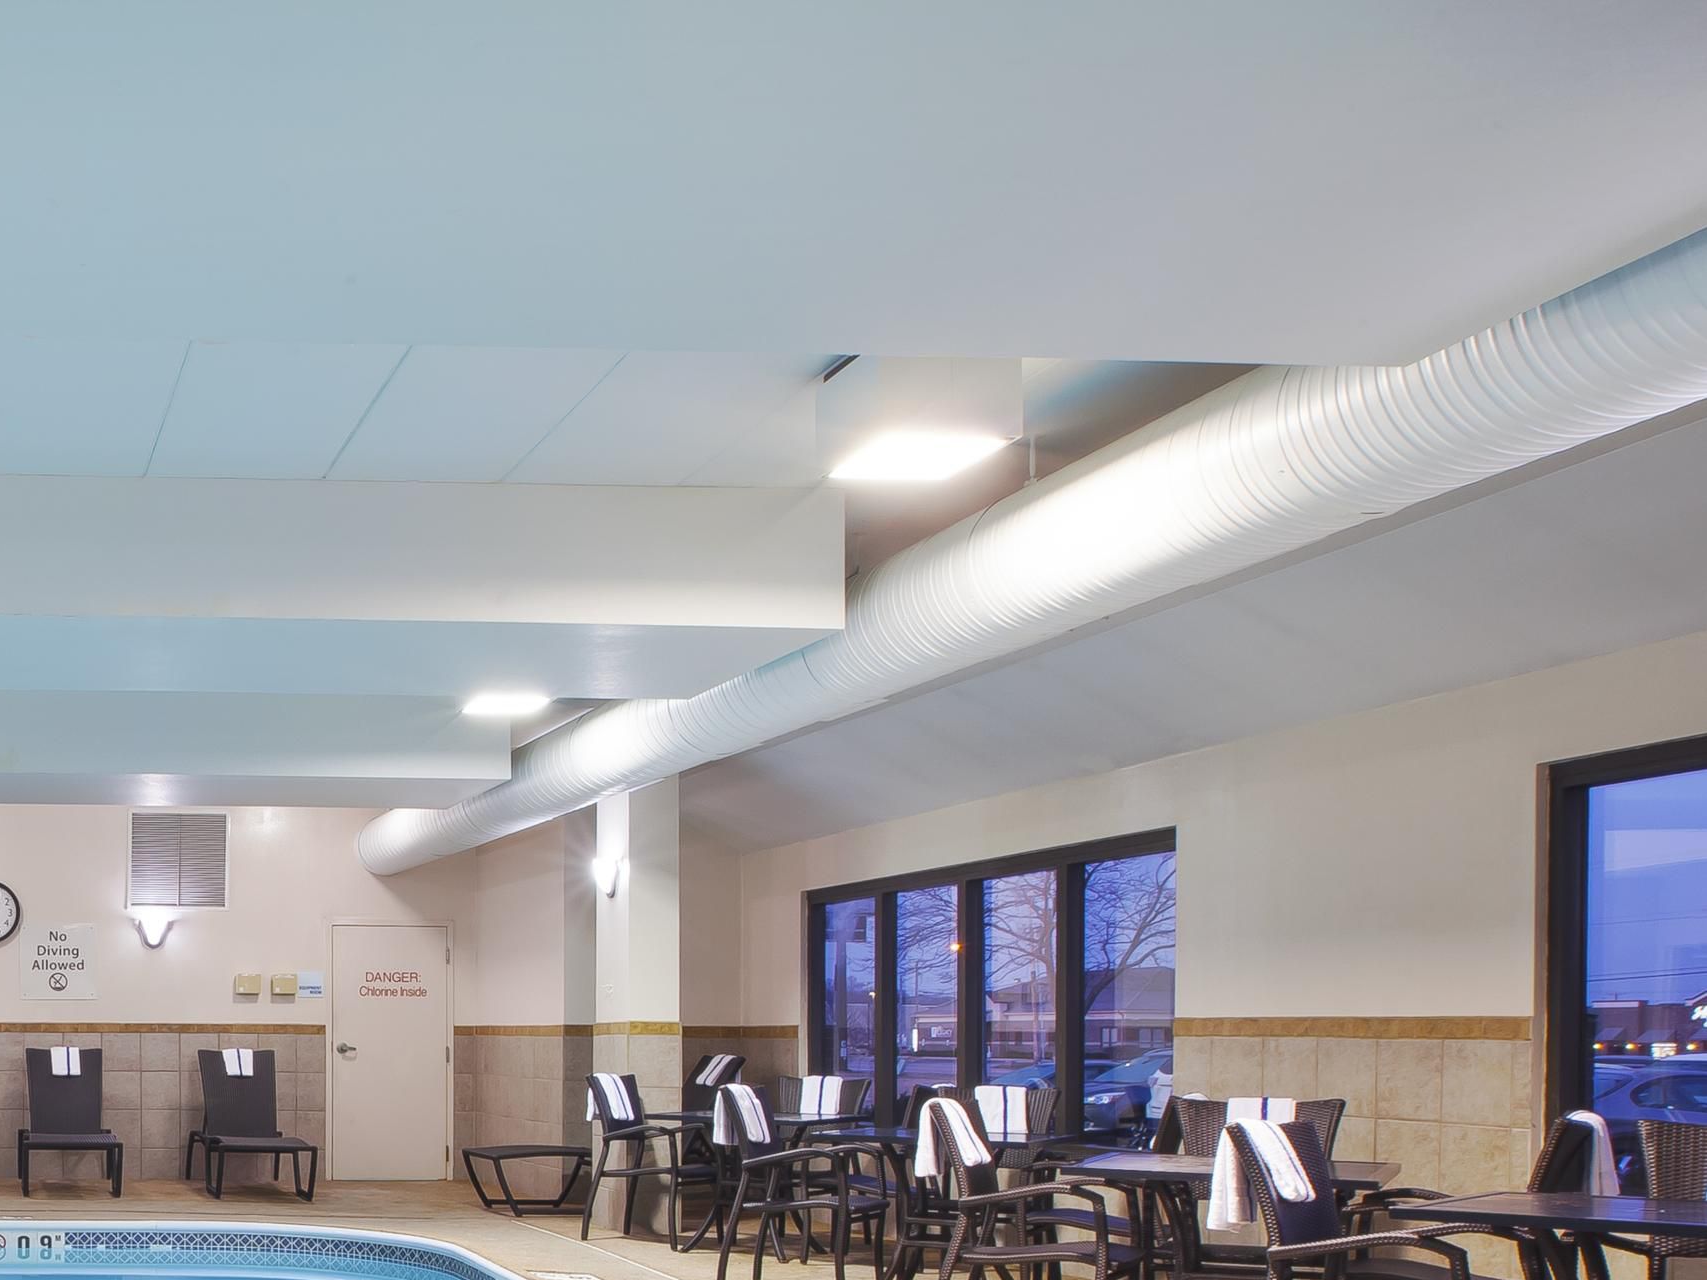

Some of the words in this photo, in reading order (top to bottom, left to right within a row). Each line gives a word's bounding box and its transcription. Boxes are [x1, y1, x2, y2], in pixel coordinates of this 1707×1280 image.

[4, 897, 10, 906] 2
[7, 908, 13, 917] 3
[49, 930, 67, 942] No
[37, 945, 79, 959] Diving
[31, 959, 85, 971] Allowed
[365, 971, 422, 983] DANGER:
[359, 985, 399, 997] Chlorine
[399, 986, 428, 997] Inside
